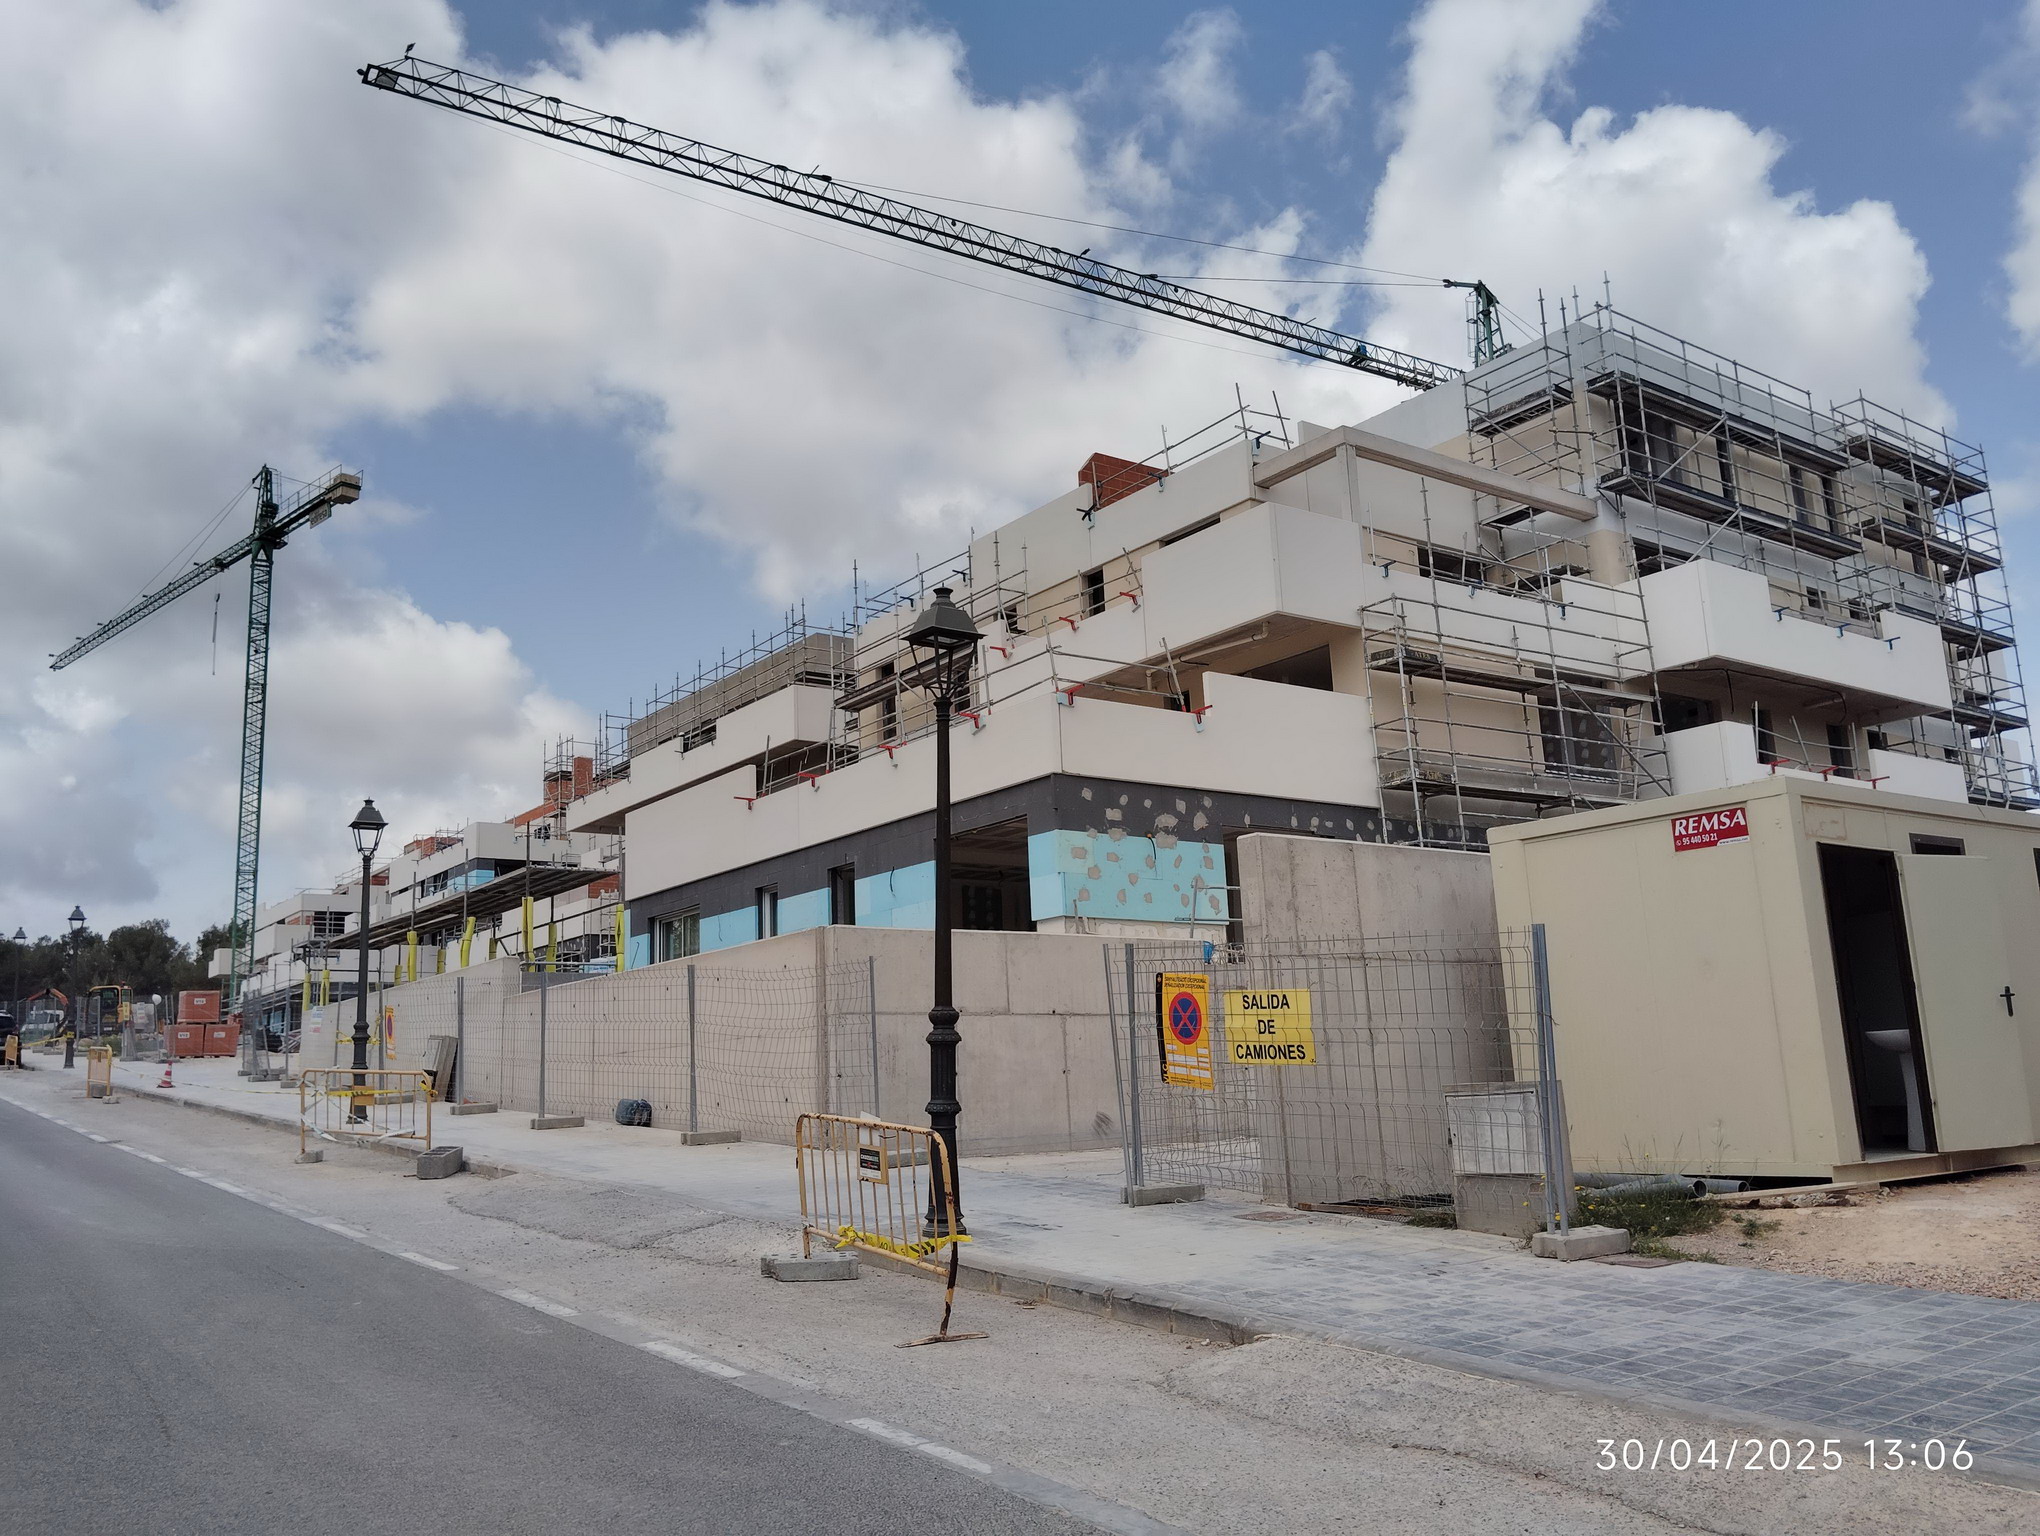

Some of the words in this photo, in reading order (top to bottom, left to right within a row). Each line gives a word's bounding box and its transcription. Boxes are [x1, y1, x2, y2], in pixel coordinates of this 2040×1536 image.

[1674, 809, 1746, 837] REMSA
[1682, 837, 1690, 846] 95
[1690, 835, 1702, 844] 440
[1702, 834, 1710, 842] 50
[1710, 832, 1718, 841] 21
[1242, 994, 1290, 1010] SALIDA
[1257, 1019, 1276, 1035] DE
[1236, 1043, 1307, 1060] CAMIONES
